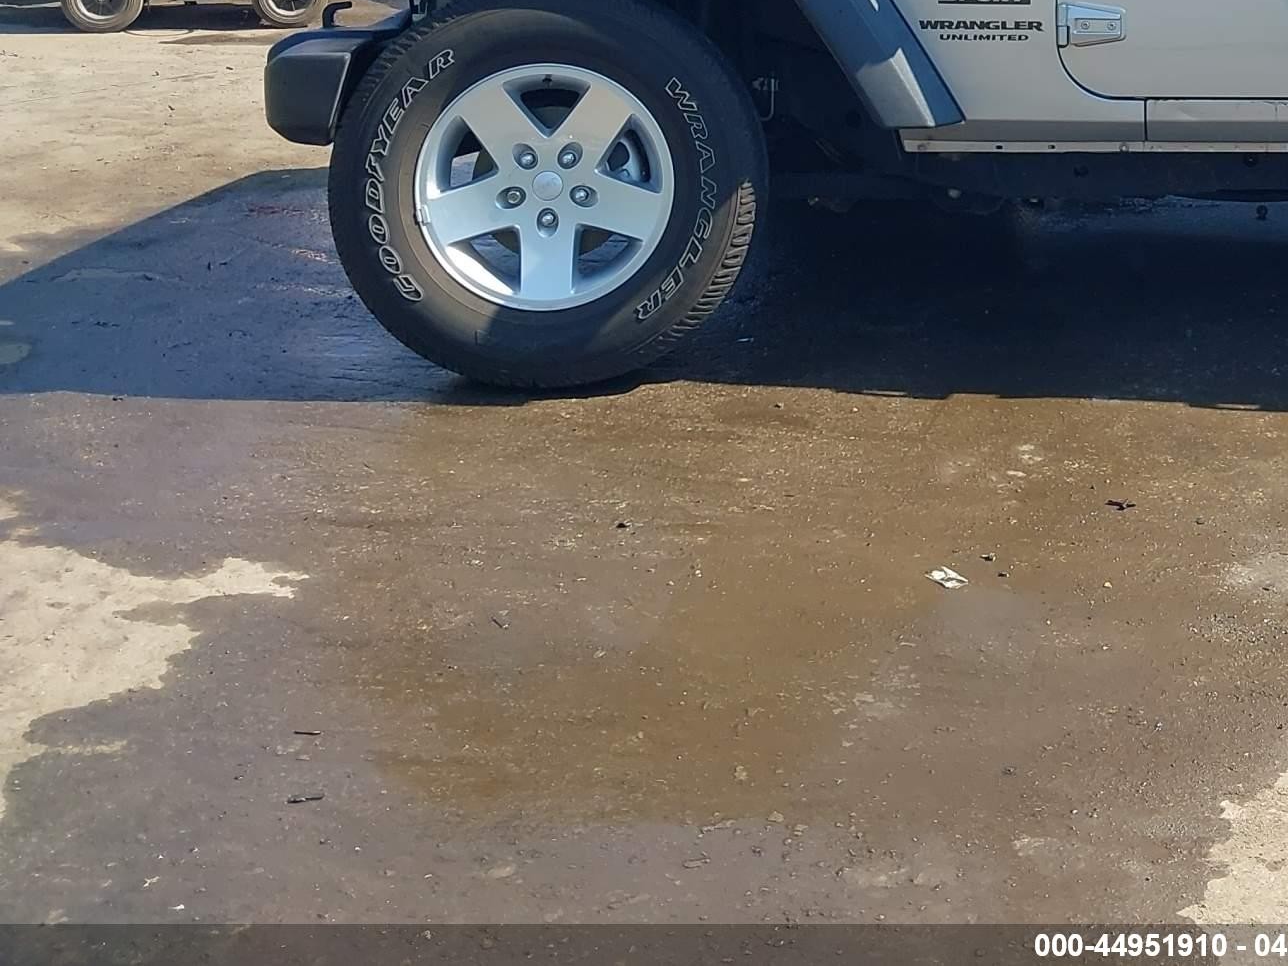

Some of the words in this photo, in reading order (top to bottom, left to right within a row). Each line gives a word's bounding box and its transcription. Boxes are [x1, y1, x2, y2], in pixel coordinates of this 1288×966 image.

[920, 20, 1043, 32] WRANGLER
[365, 48, 456, 303] GOODYEAR
[634, 77, 717, 321] WRANGLER
